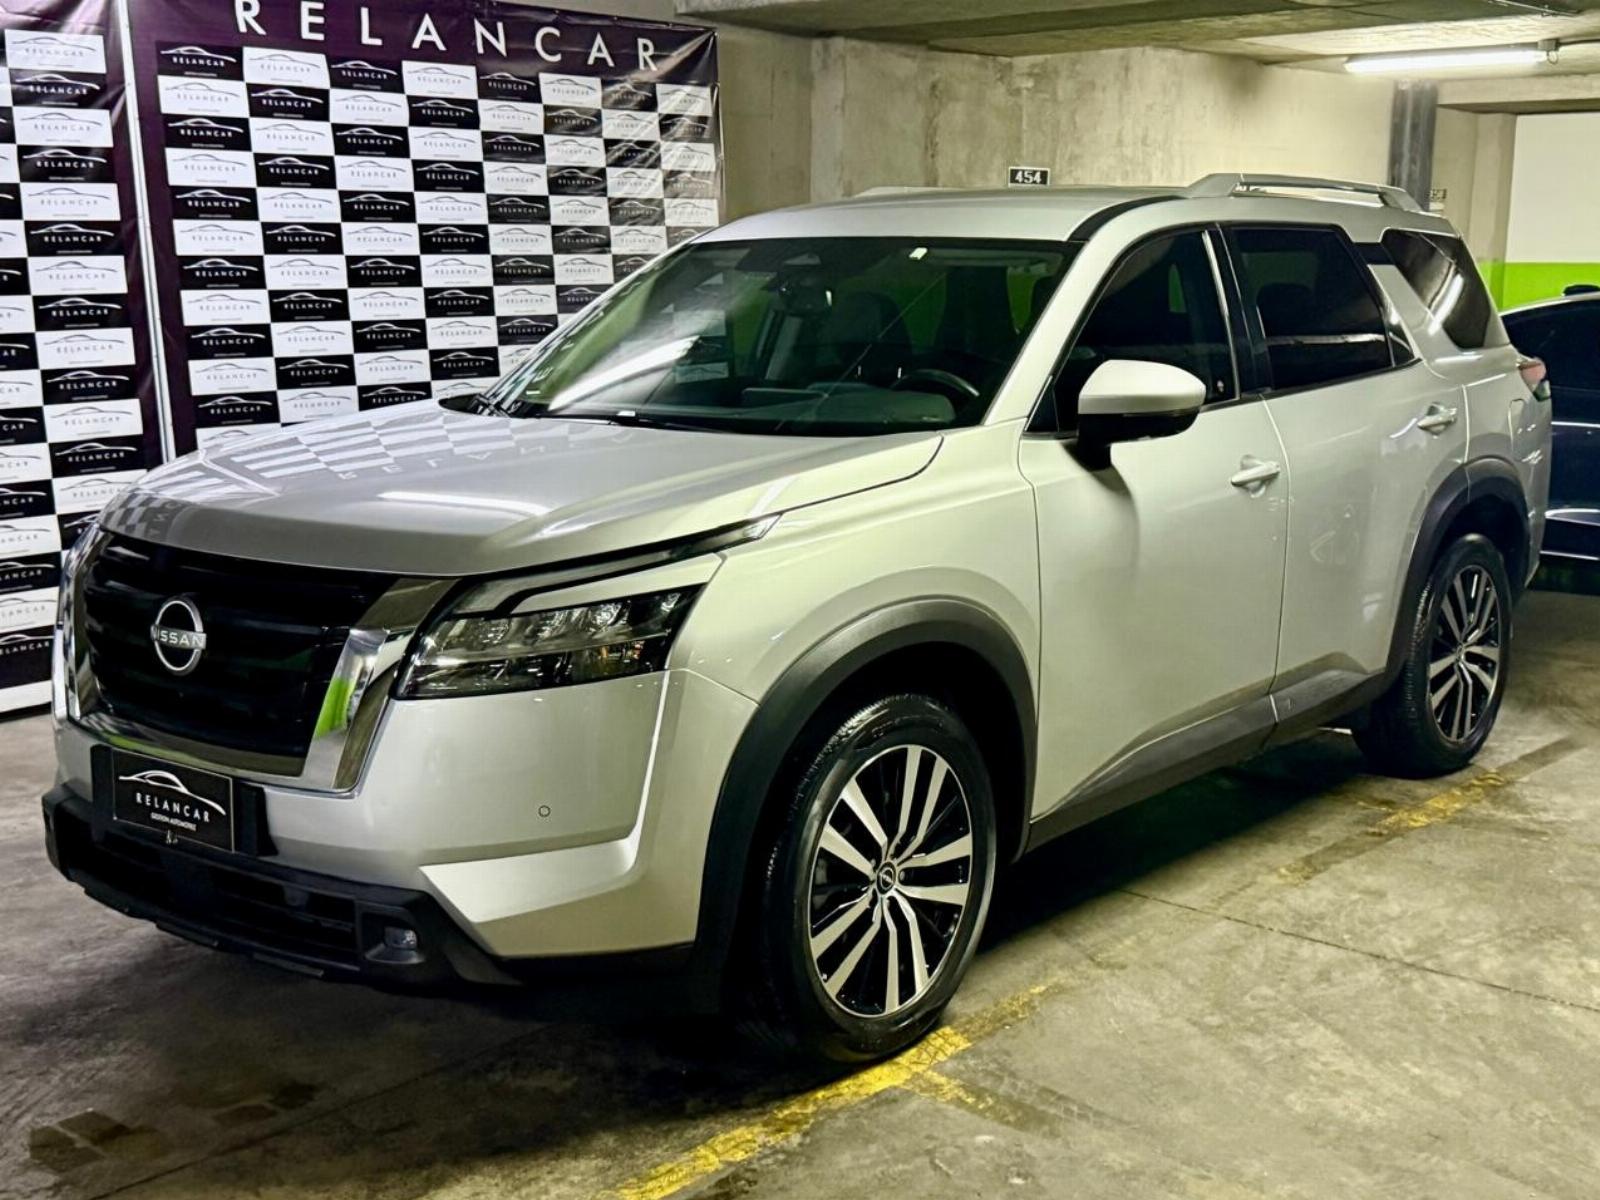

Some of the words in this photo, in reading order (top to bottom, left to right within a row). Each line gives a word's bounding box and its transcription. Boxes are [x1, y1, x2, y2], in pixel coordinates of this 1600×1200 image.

[234, 0, 658, 71] RELANCAR
[172, 56, 225, 67] RELANCAR
[341, 70, 388, 80] RELANCAR
[28, 85, 88, 96] RELANCAR
[262, 99, 313, 109] RELANCAR
[421, 108, 466, 117] RELANCAR
[179, 128, 233, 138] RELANCAR
[346, 137, 394, 145] RELANCAR
[36, 160, 94, 169] RELANCAR
[269, 167, 319, 176] RELANCAR
[425, 173, 471, 181] RELANCAR
[1014, 170, 1042, 184] 454
[187, 200, 240, 208] RELANCAR
[353, 203, 400, 211] RELANCAR
[43, 235, 102, 243] RELANCAR
[276, 235, 326, 243] RELANCAR
[194, 270, 248, 278] RELANCAR
[437, 298, 481, 306] RELANCAR
[566, 296, 595, 304] RELAN
[283, 302, 333, 310] RELANCAR
[51, 308, 109, 317] RELANCAR
[365, 332, 412, 340] RELANCAR
[202, 338, 254, 346] RELANCAR
[442, 360, 486, 369] RELANCAR
[290, 367, 339, 377] RELANCAR
[59, 380, 117, 390] RELANCAR
[371, 394, 418, 404] RELANCAR
[210, 405, 261, 415] RELANCAR
[67, 451, 125, 462] RELANCAR
[0, 461, 28, 469] NCAR
[3, 496, 34, 505] NCAR
[0, 534, 38, 543] ANCAR
[0, 569, 43, 581] ANCAR
[0, 605, 46, 617] LANCAR
[0, 641, 50, 655] ELANCAR
[135, 792, 210, 822] RELANCAR
